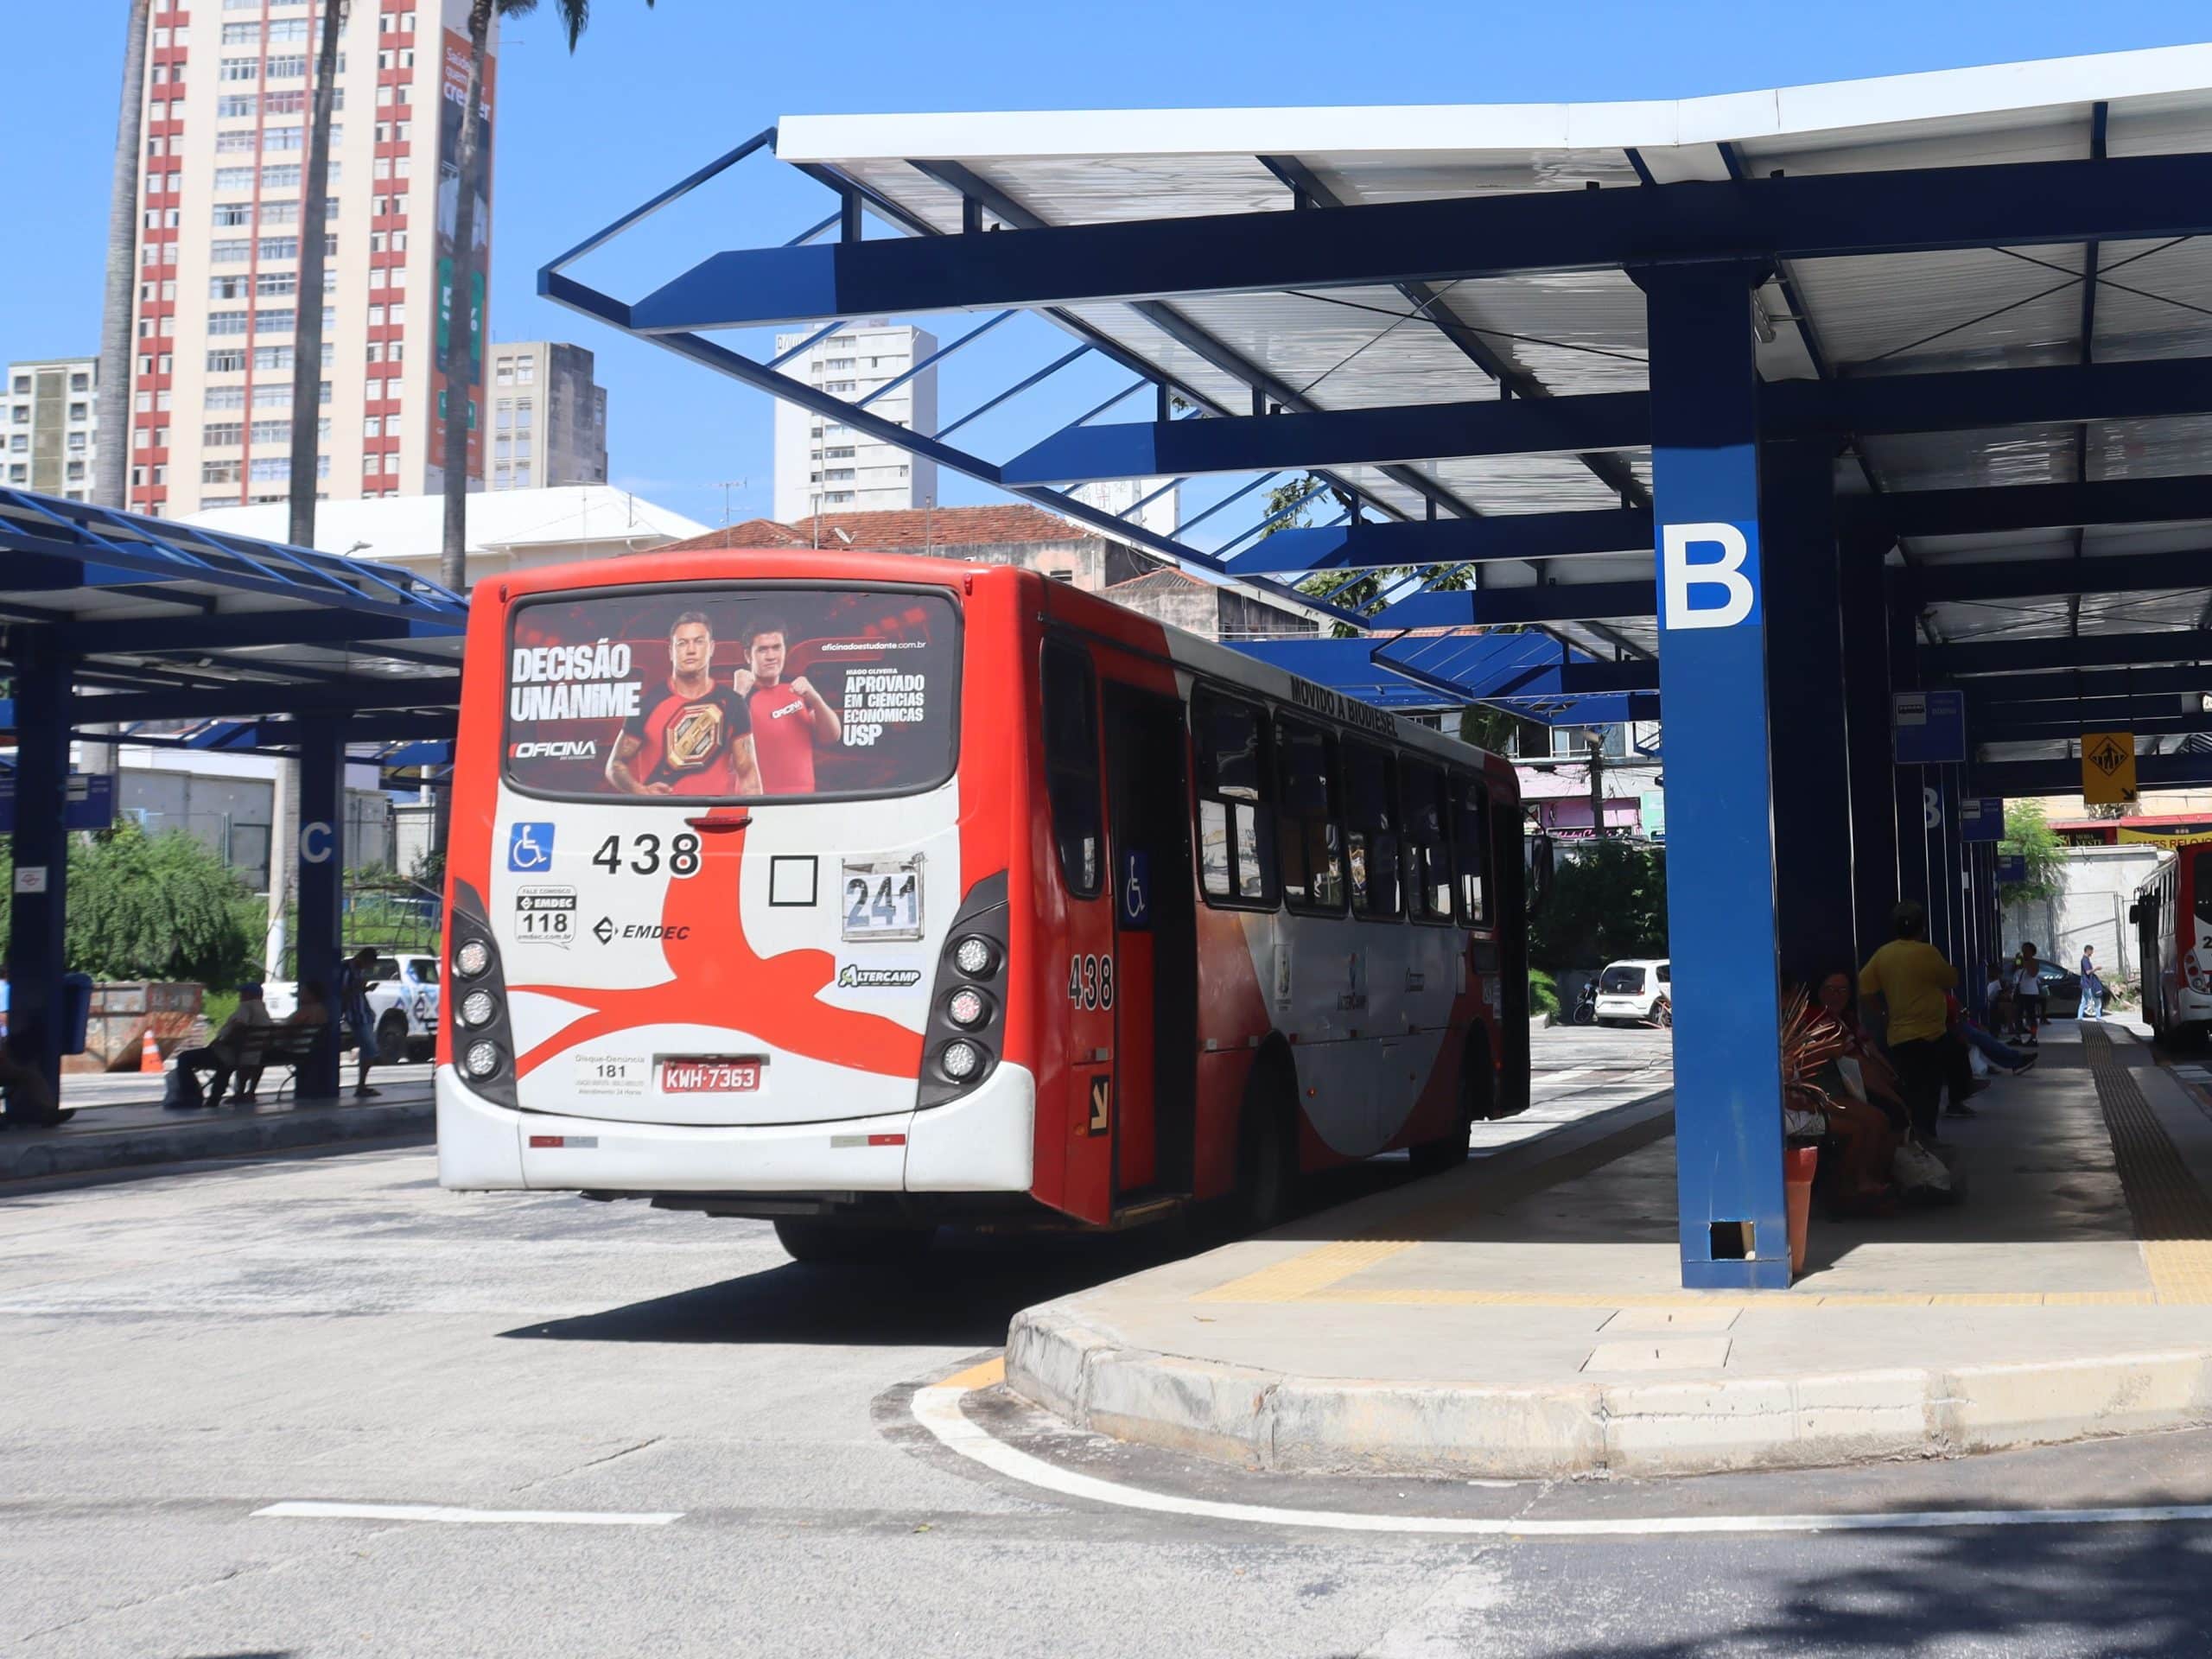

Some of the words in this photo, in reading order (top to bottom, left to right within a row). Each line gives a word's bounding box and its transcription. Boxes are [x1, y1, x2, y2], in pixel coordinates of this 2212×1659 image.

[1663, 523, 1753, 629] B
[512, 638, 631, 683] DECISÃO
[845, 675, 925, 693] APROVADO
[511, 682, 642, 721] UNÂNIME
[844, 694, 862, 708] EM
[868, 692, 925, 707] CIÊNCIAS
[1291, 675, 1335, 715] MOVIDO
[1338, 694, 1345, 719] A
[1347, 696, 1398, 739] BIODIESEL
[844, 708, 924, 723] ECONÔMICAS
[843, 724, 882, 746] USP
[515, 741, 596, 758] OFICINA
[302, 822, 332, 863] C
[592, 833, 700, 875] 438
[534, 899, 573, 908] EMDEC
[847, 875, 917, 927] 241
[524, 913, 567, 932] 118
[622, 925, 690, 939] EMDEC
[839, 964, 920, 988] ALTERCAMP
[1068, 954, 1113, 1011] 438
[596, 1065, 626, 1077] 181
